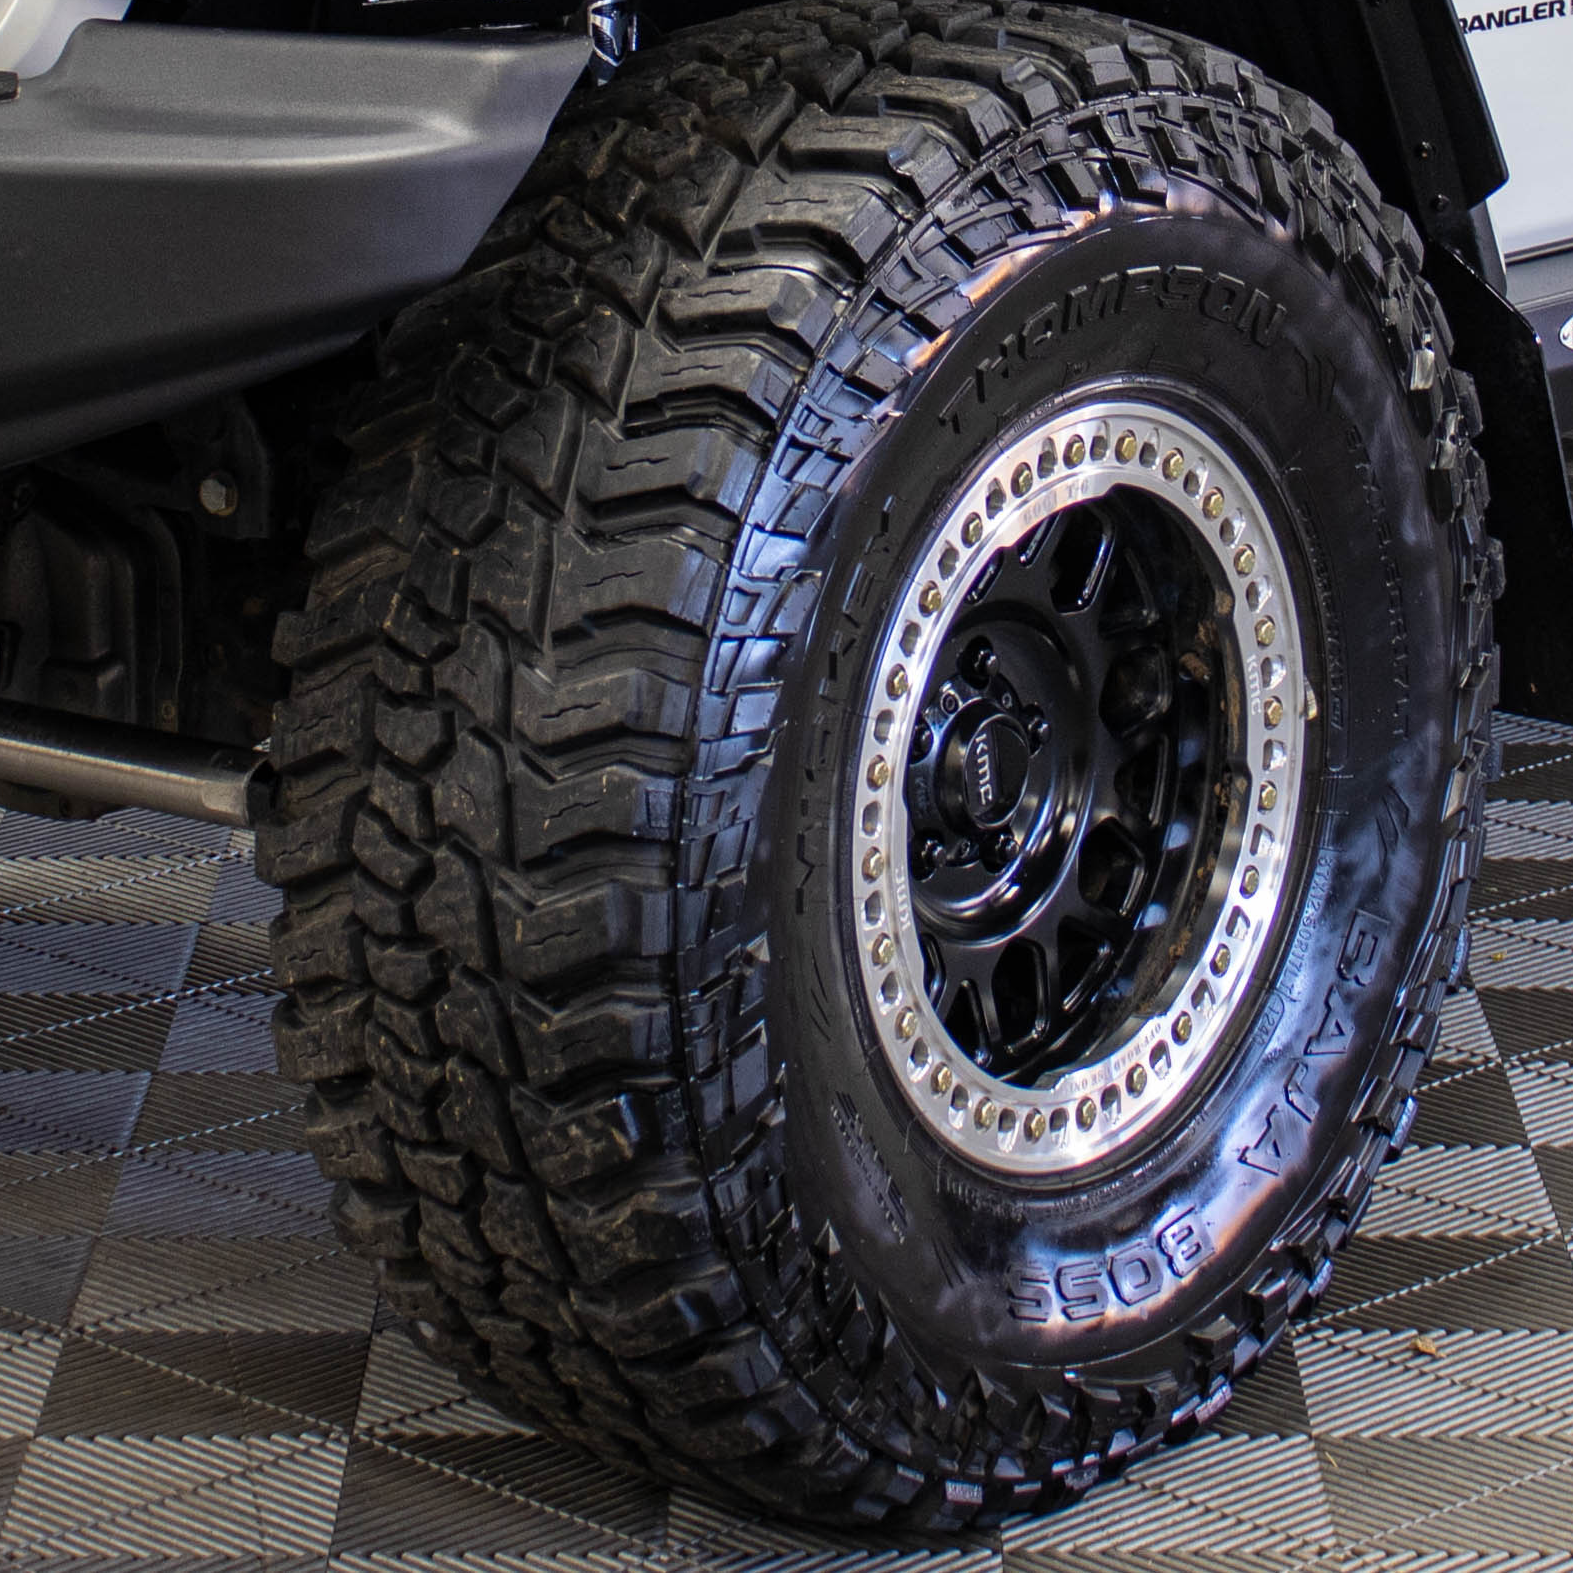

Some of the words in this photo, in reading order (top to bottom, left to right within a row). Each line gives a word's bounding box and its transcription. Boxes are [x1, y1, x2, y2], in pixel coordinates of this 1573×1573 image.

[937, 264, 1289, 434] THOMPSON
[975, 732, 993, 805] KMC
[1237, 908, 1391, 1178] BAJA
[1005, 1204, 1218, 1324] BOSS
